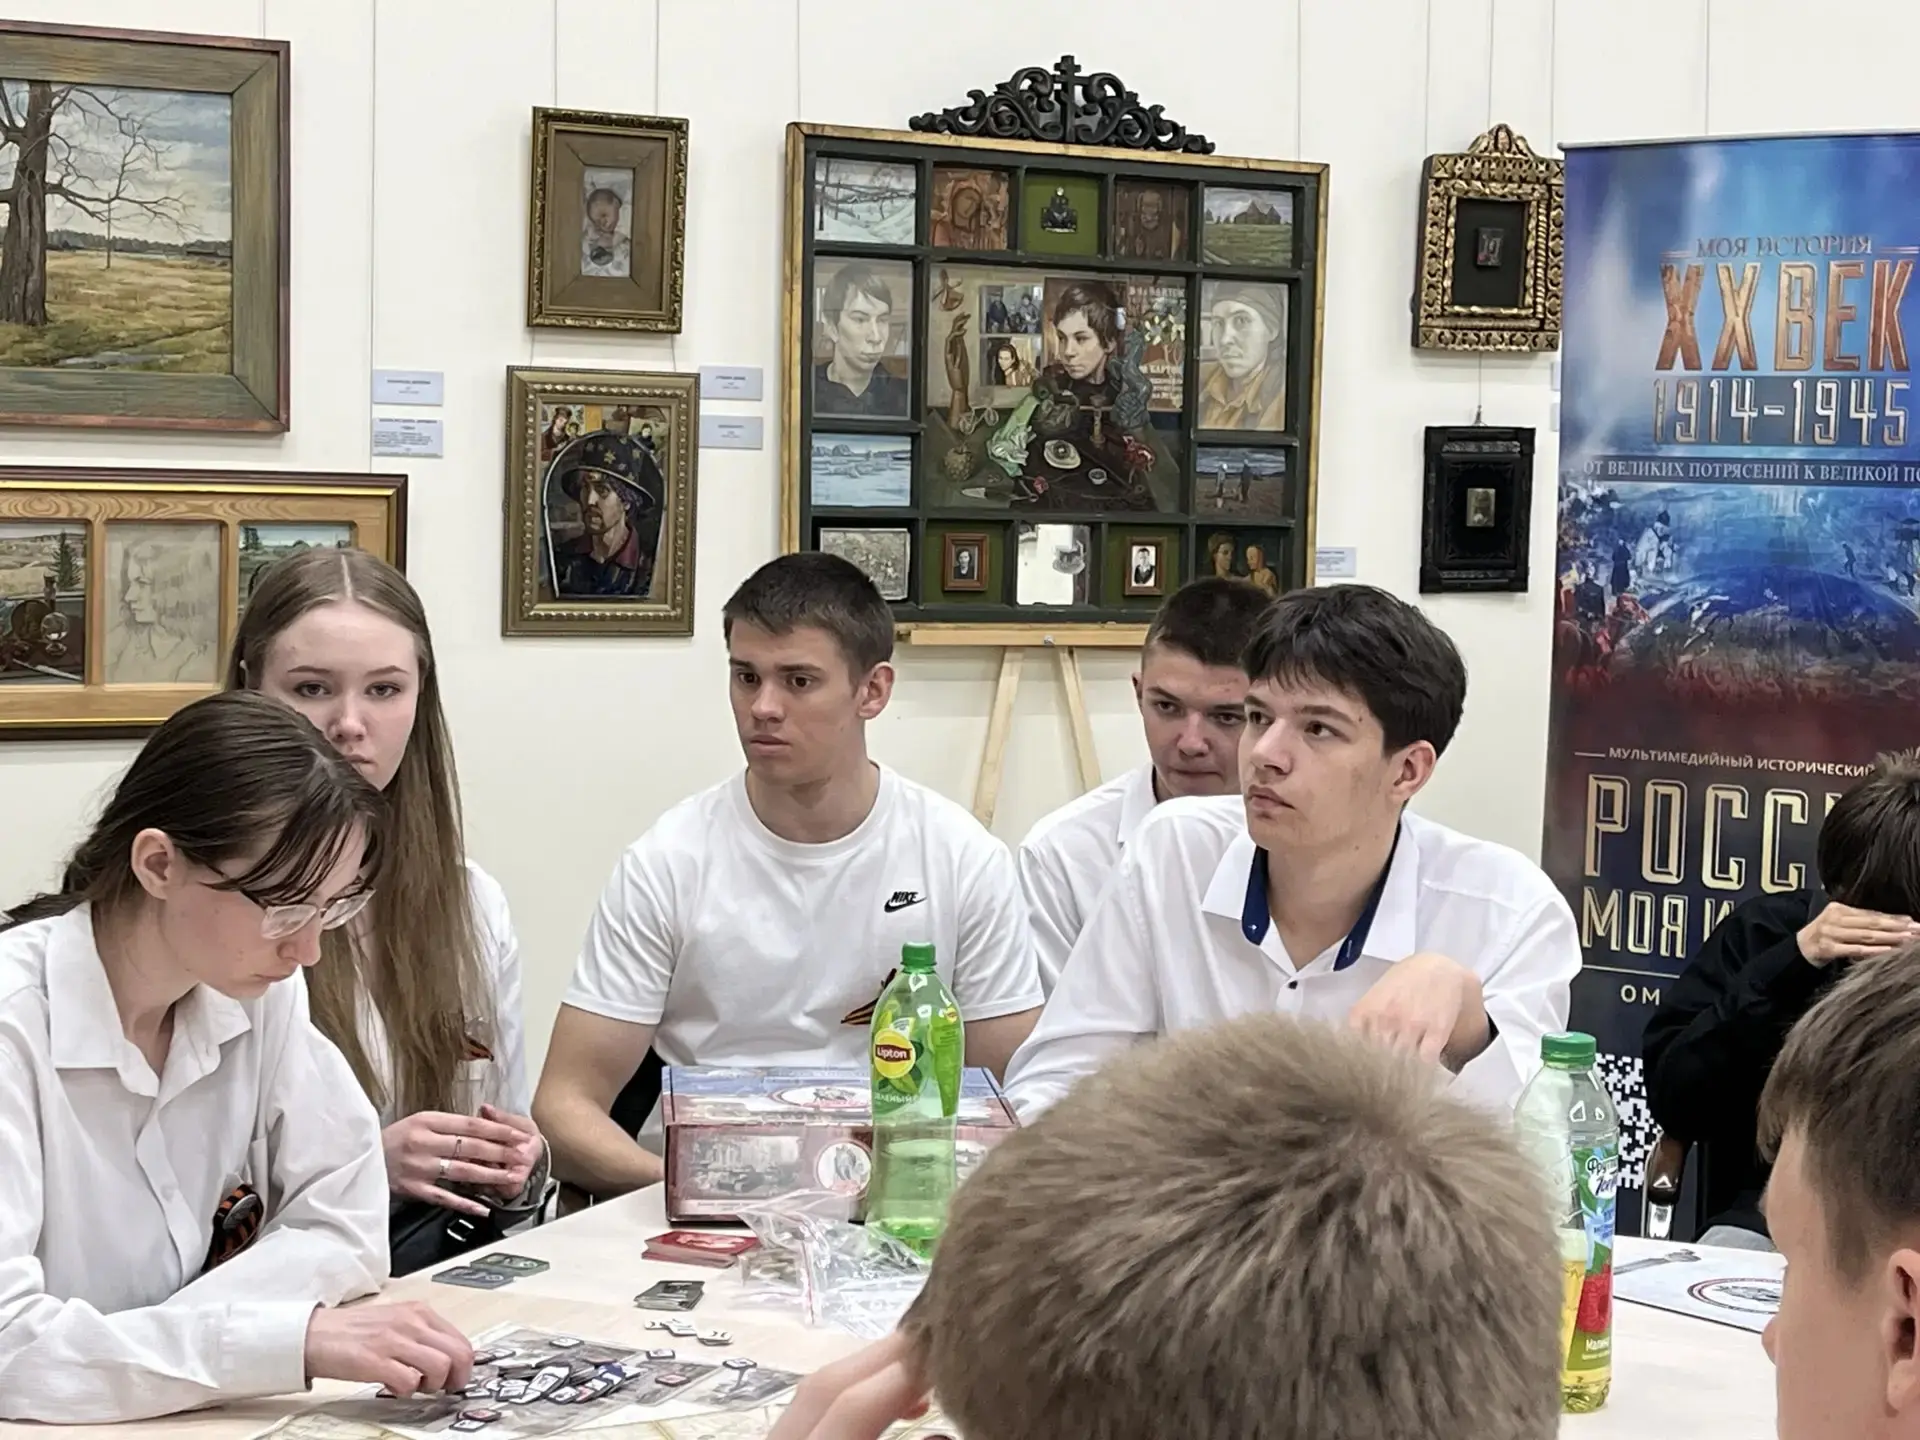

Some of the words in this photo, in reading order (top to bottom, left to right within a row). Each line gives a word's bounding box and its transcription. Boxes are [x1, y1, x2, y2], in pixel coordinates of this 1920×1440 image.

[1696, 237, 1748, 257] МОЯ
[1756, 235, 1873, 256] ИСТОРИЯ
[1774, 259, 1914, 372] ВЕК
[1654, 377, 1911, 446] 1914-1945
[1583, 461, 1604, 475] ОТ
[1608, 461, 1684, 477] ВЕЛИКИХ
[1688, 461, 1799, 479] ПОТРЯСЕНИЙ
[1804, 464, 1815, 480] К
[1820, 463, 1899, 482] ВЕЛИКОЙ
[1608, 747, 1754, 769] МУЛЬТИМЕДИЙНЫЙ
[1584, 773, 1843, 894] РОСС
[890, 891, 919, 904] NIKE
[1582, 886, 1688, 959] МОЯ
[876, 1046, 908, 1059] Lipton
